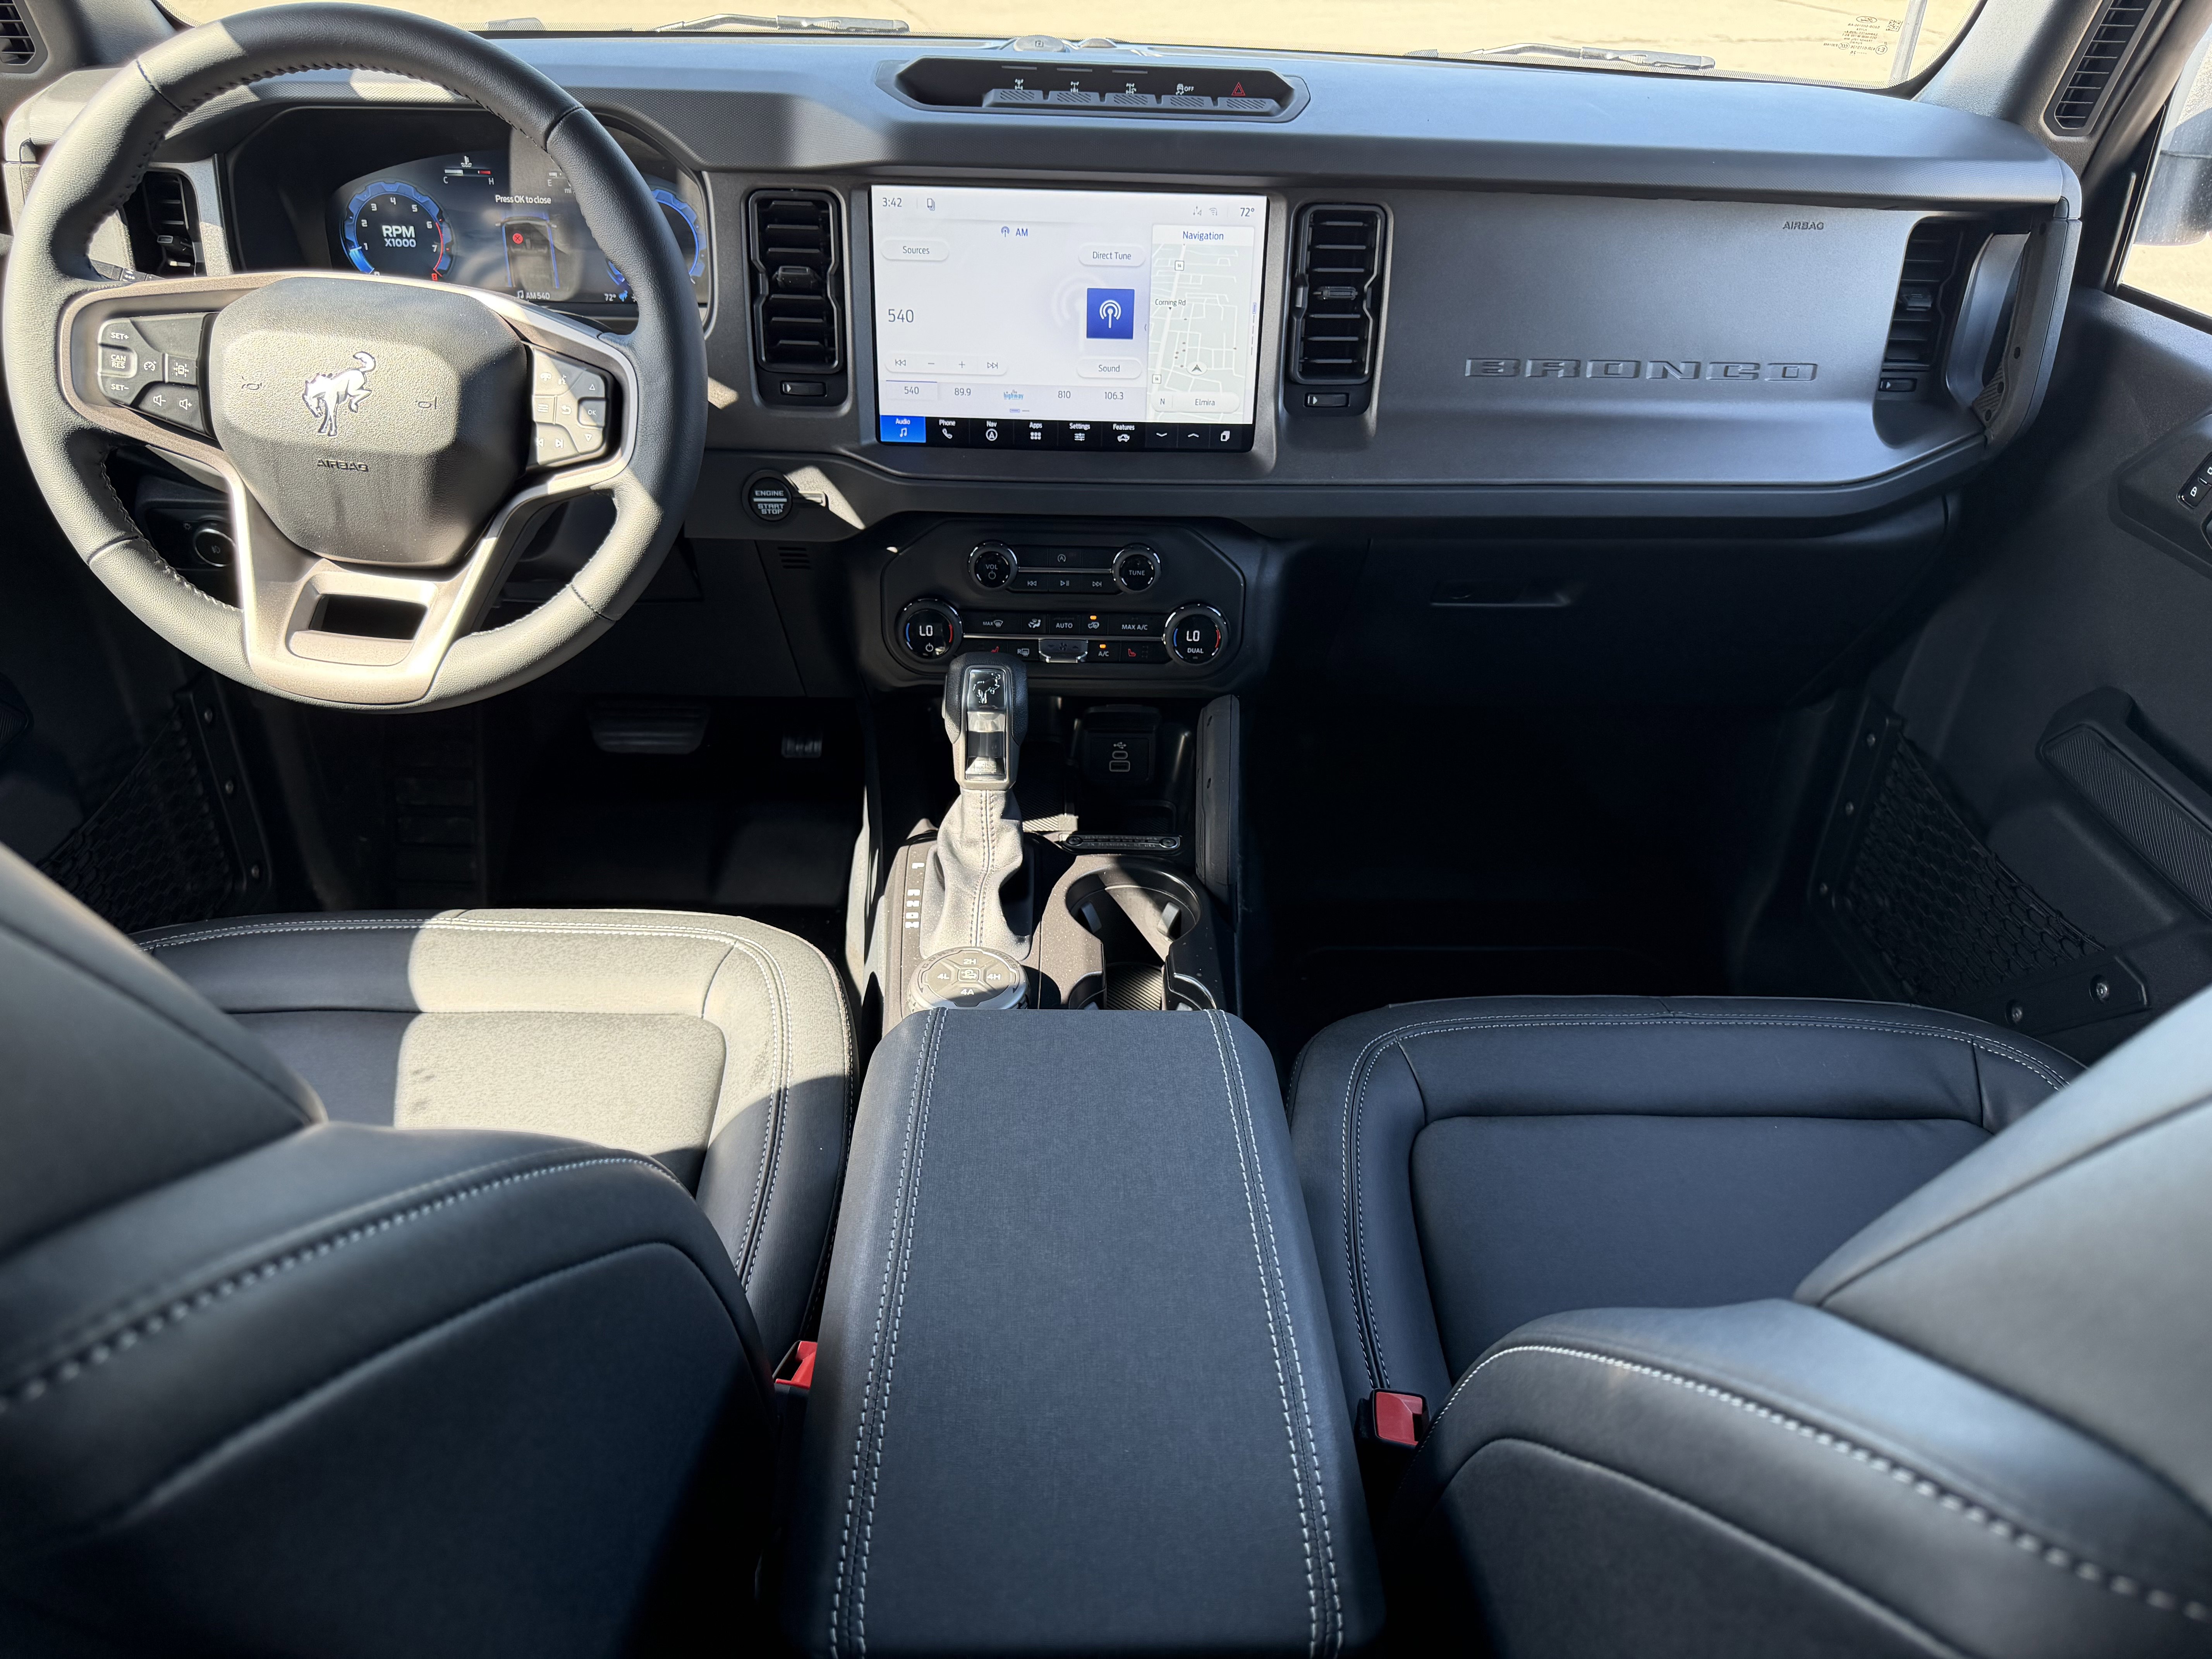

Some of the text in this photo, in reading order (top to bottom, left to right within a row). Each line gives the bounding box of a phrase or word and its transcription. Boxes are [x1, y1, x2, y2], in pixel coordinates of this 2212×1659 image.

[443, 176, 448, 184] C
[488, 177, 494, 185] H
[390, 197, 396, 205] 4
[495, 194, 514, 203] Press
[514, 195, 525, 203] OK
[534, 196, 551, 204] close
[882, 197, 903, 208] 3:42
[412, 204, 418, 212] 5
[1240, 207, 1255, 217] 72°
[361, 219, 368, 227] 2
[426, 221, 433, 229] 6
[1782, 221, 1824, 230] AIRBAG
[382, 225, 415, 238] RPM
[1015, 228, 1029, 237] AM
[1182, 231, 1224, 241] Navigation
[384, 238, 417, 248] X1000
[432, 244, 437, 252] 7
[902, 246, 930, 255] Sources
[1092, 251, 1132, 260] Direct Tune
[431, 273, 438, 281] 8
[604, 293, 617, 302] 72°
[1155, 299, 1177, 307] Corning
[888, 308, 914, 323] 540
[110, 354, 127, 362] CAN
[1098, 364, 1120, 373] Sound
[1465, 358, 1818, 382] BRONCO
[904, 386, 919, 395] 540
[954, 388, 971, 396] 89.9
[1058, 390, 1071, 398] 810
[1003, 392, 1024, 400] highway
[1104, 392, 1124, 400] 106.3
[1069, 422, 1091, 431] Settings
[317, 458, 369, 472] AIRBAG
[919, 625, 933, 637] LO
[1186, 630, 1200, 642] LO
